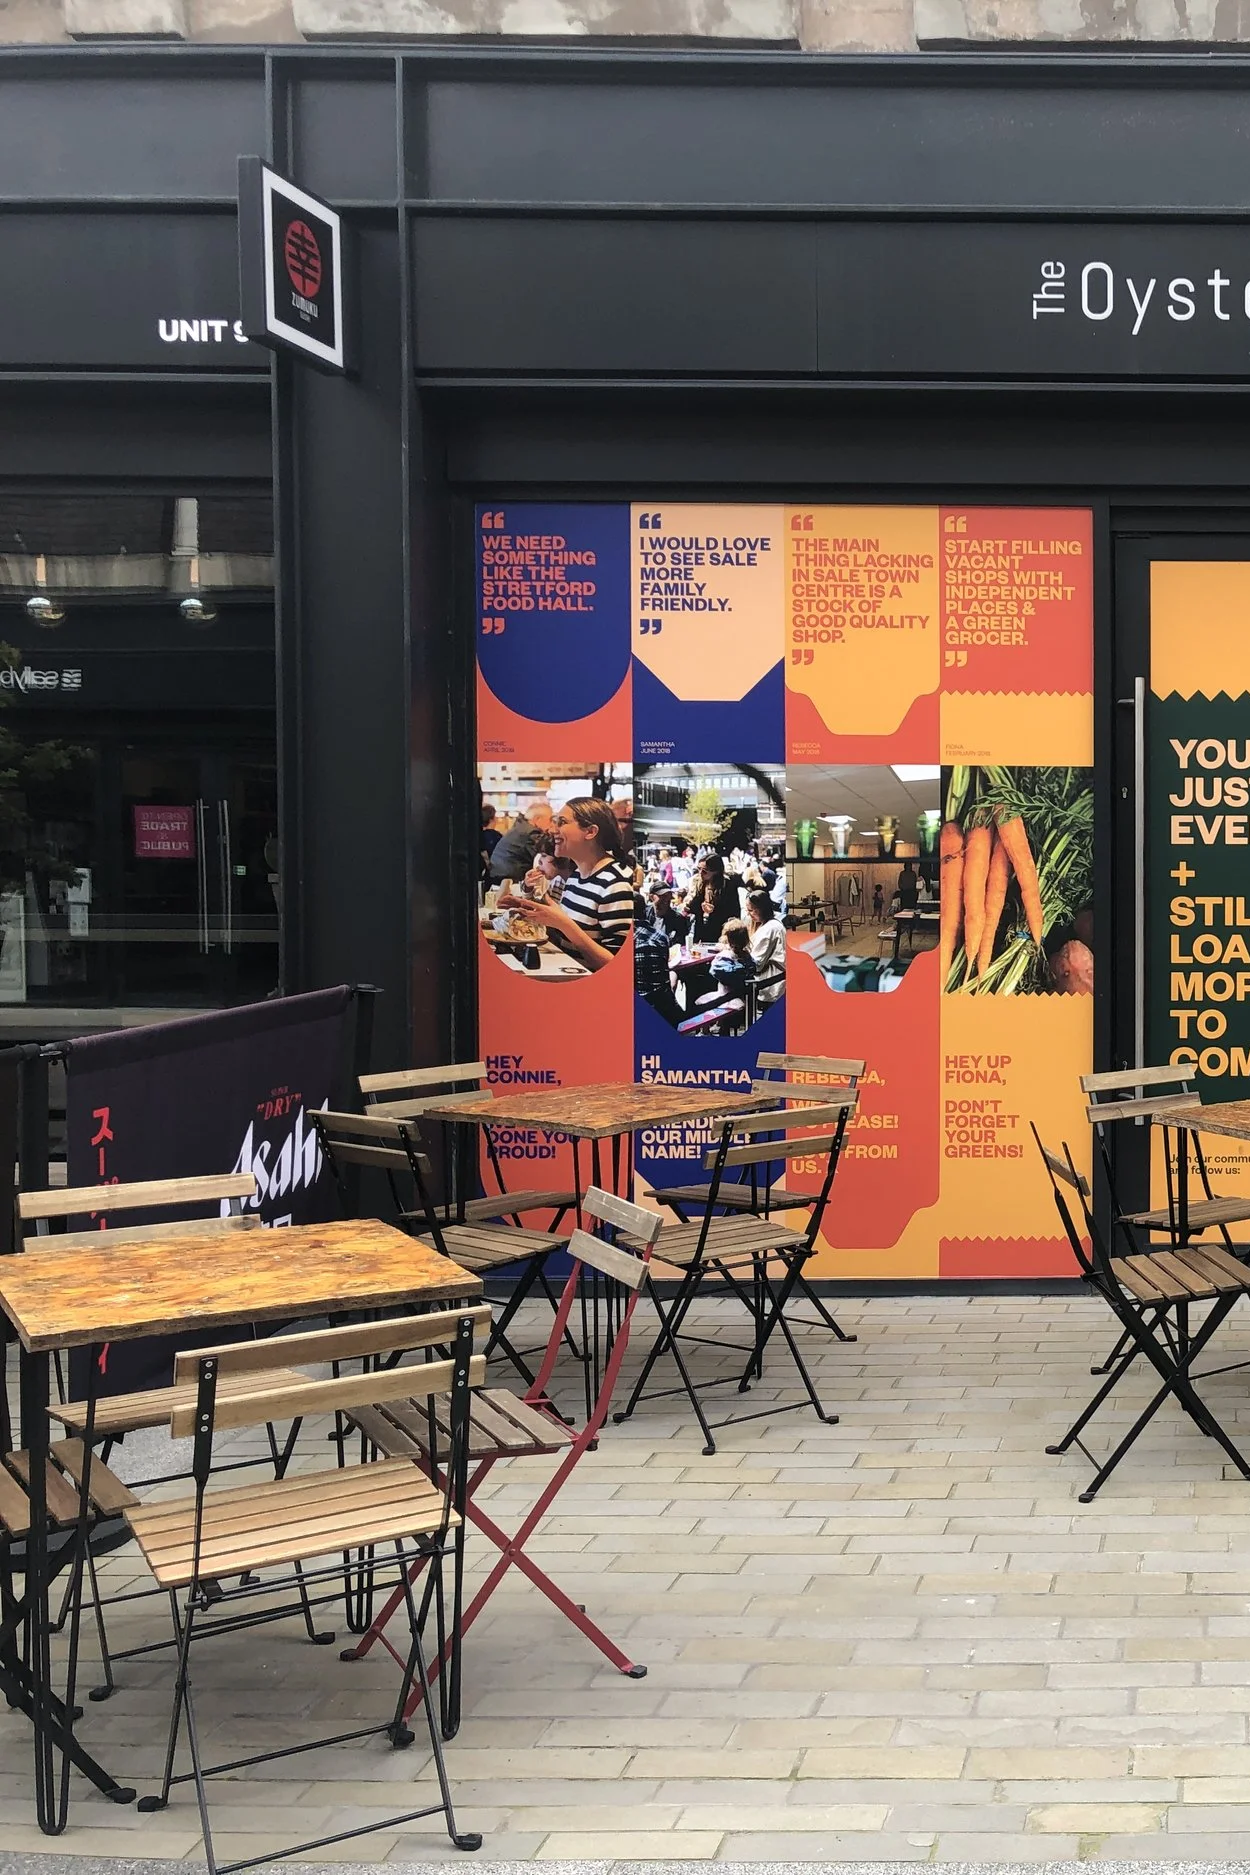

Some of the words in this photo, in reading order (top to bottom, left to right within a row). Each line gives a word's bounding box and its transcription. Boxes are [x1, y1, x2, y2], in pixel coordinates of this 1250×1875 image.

[1032, 261, 1065, 319] The
[158, 319, 227, 342] UNIT
[483, 536, 514, 549] WE
[516, 536, 565, 549] NEED
[640, 537, 644, 550] I
[648, 537, 719, 550] WOULD
[723, 537, 770, 550] LOVE
[792, 538, 829, 551] THE
[832, 538, 879, 552] MAIN
[945, 540, 1007, 554] START
[1011, 540, 1082, 555] FILLING
[483, 552, 596, 565] SOMETHING
[640, 552, 666, 566] TO
[674, 552, 705, 566] SEE
[709, 552, 757, 566] SALE
[792, 554, 849, 568] THING
[853, 554, 933, 568] LACKING
[945, 555, 1022, 569] VACANT
[483, 567, 525, 580] LIKE
[528, 567, 565, 580] THE
[640, 568, 694, 581] MORE
[792, 570, 809, 582] IN
[813, 570, 859, 582] SALE
[864, 570, 919, 583] TOWN
[945, 571, 1009, 584] SHOPS
[1012, 571, 1063, 585] WITH
[483, 582, 595, 595] STRETFORD
[640, 583, 706, 596] FAMILY
[792, 585, 866, 598] CENTRE
[869, 585, 885, 598] IS
[889, 585, 903, 598] A
[945, 586, 1075, 600] INDEPENDENT
[483, 597, 534, 610] FOOD
[539, 597, 593, 611] HALL.
[640, 598, 732, 611] FRIENDLY.
[792, 600, 855, 613] STOCK
[858, 600, 882, 613] OF
[945, 601, 1018, 615] PLACES
[1022, 601, 1035, 615] &
[792, 615, 846, 628] GOOD
[850, 615, 930, 629] QUALITY
[945, 617, 959, 630] A
[963, 617, 1025, 630] GREEN
[792, 630, 845, 643] SHOP.
[945, 632, 1028, 645] GROCER.
[1170, 862, 1196, 886] +
[1169, 1009, 1227, 1039] TO
[486, 1056, 523, 1069] HEY
[641, 1055, 661, 1069] HI
[945, 1056, 983, 1069] HEY
[986, 1056, 1011, 1069] UP
[486, 1071, 562, 1085] CONNIE,
[945, 1071, 1007, 1086] FIONA,
[945, 1100, 1002, 1113] DON'T
[945, 1115, 1019, 1128] FORGET
[641, 1131, 683, 1144] OUR
[945, 1130, 996, 1143] YOUR
[487, 1146, 556, 1159] PROUD!
[641, 1145, 701, 1159] NAME!
[845, 1145, 898, 1158] FROM
[945, 1145, 1023, 1158] GREENS!
[792, 1160, 821, 1173] US.
